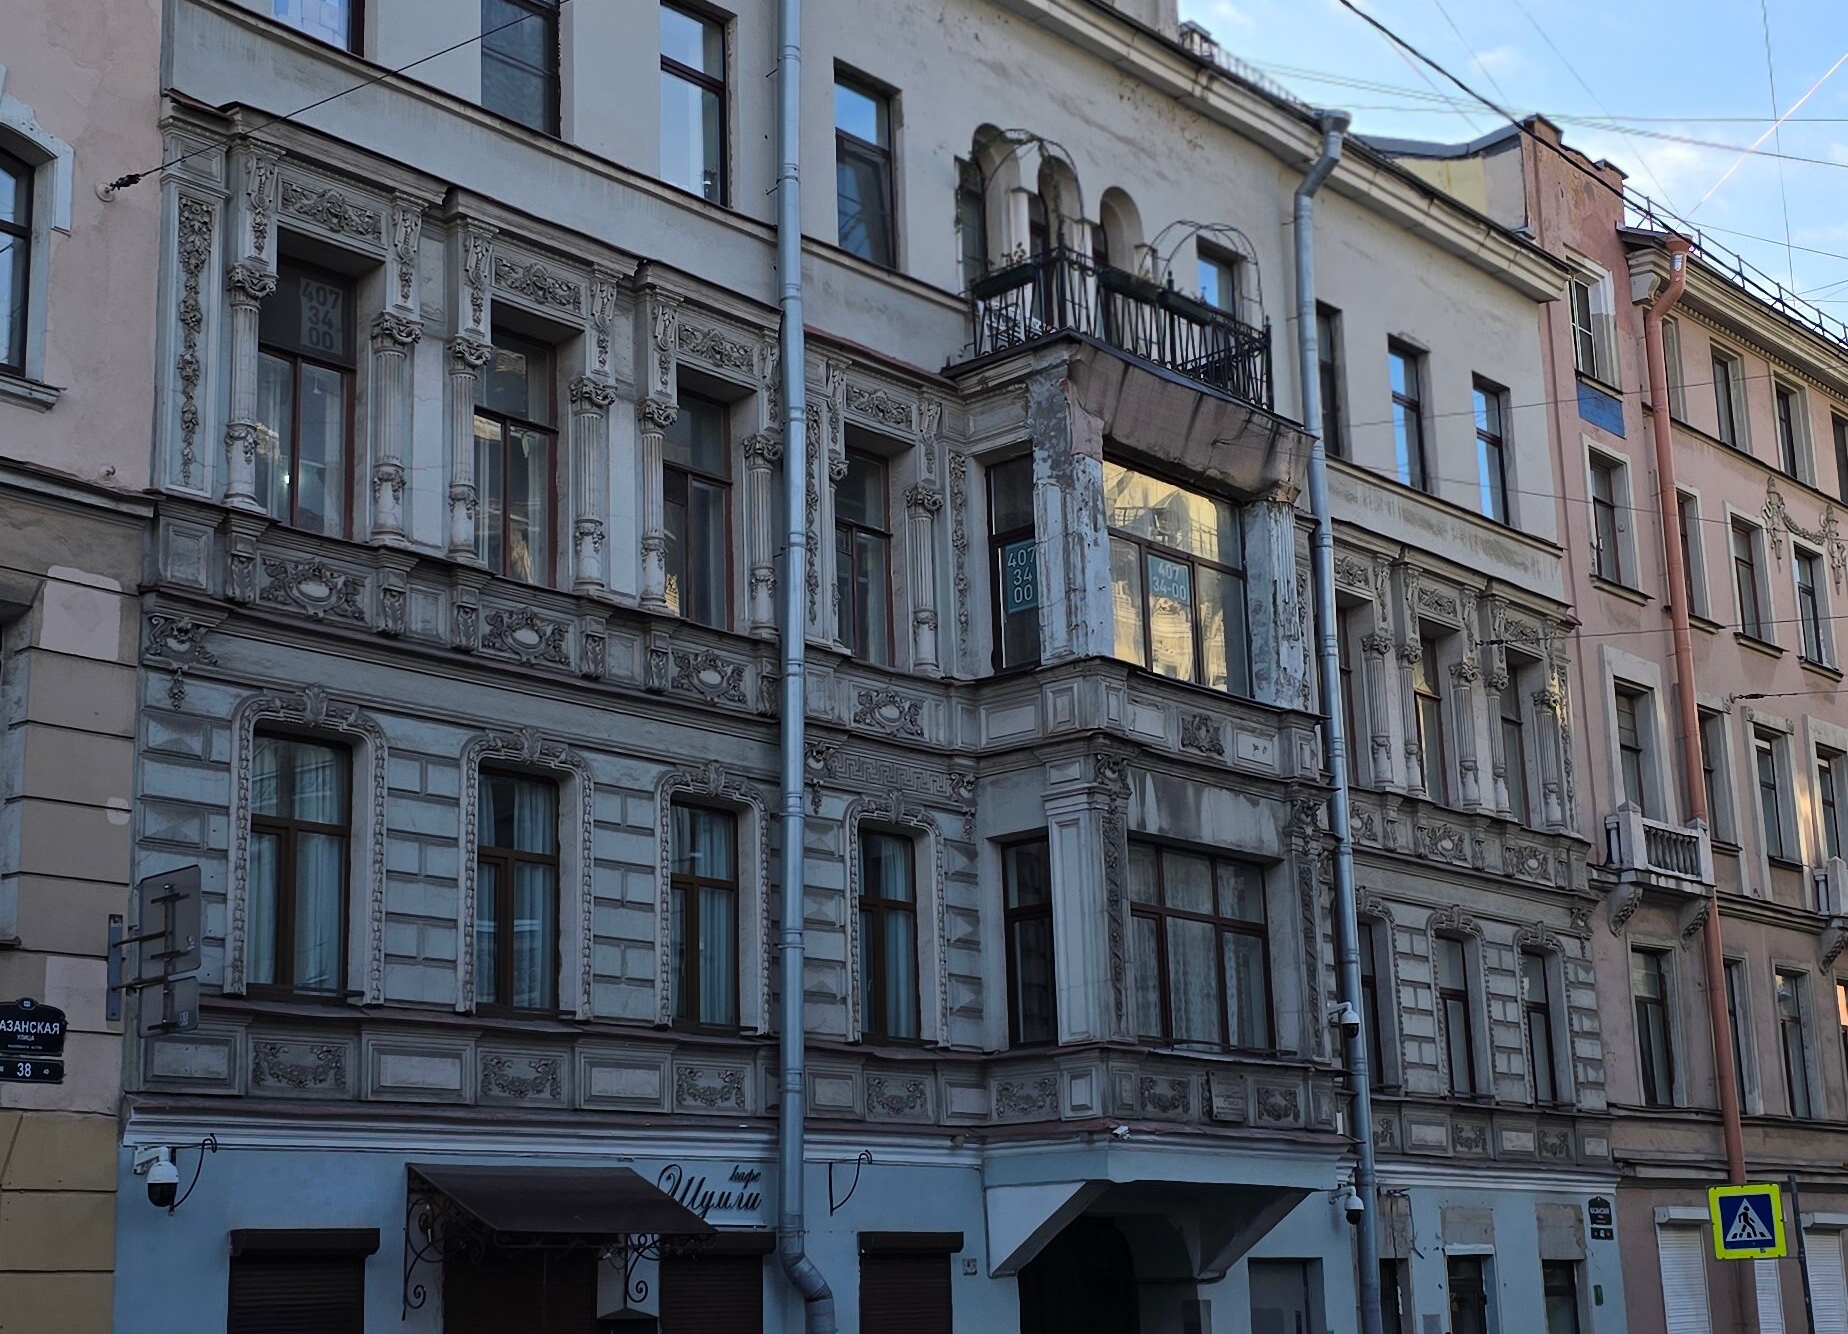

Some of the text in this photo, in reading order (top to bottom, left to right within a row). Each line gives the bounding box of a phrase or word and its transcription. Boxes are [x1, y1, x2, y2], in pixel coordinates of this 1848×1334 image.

[1008, 546, 1036, 567] 407
[1013, 566, 1033, 586] 34
[1158, 562, 1179, 581] 407
[1014, 583, 1033, 604] 00
[1152, 576, 1187, 601] 34-00
[16, 1062, 32, 1077] 38
[729, 1164, 762, 1189] кафе
